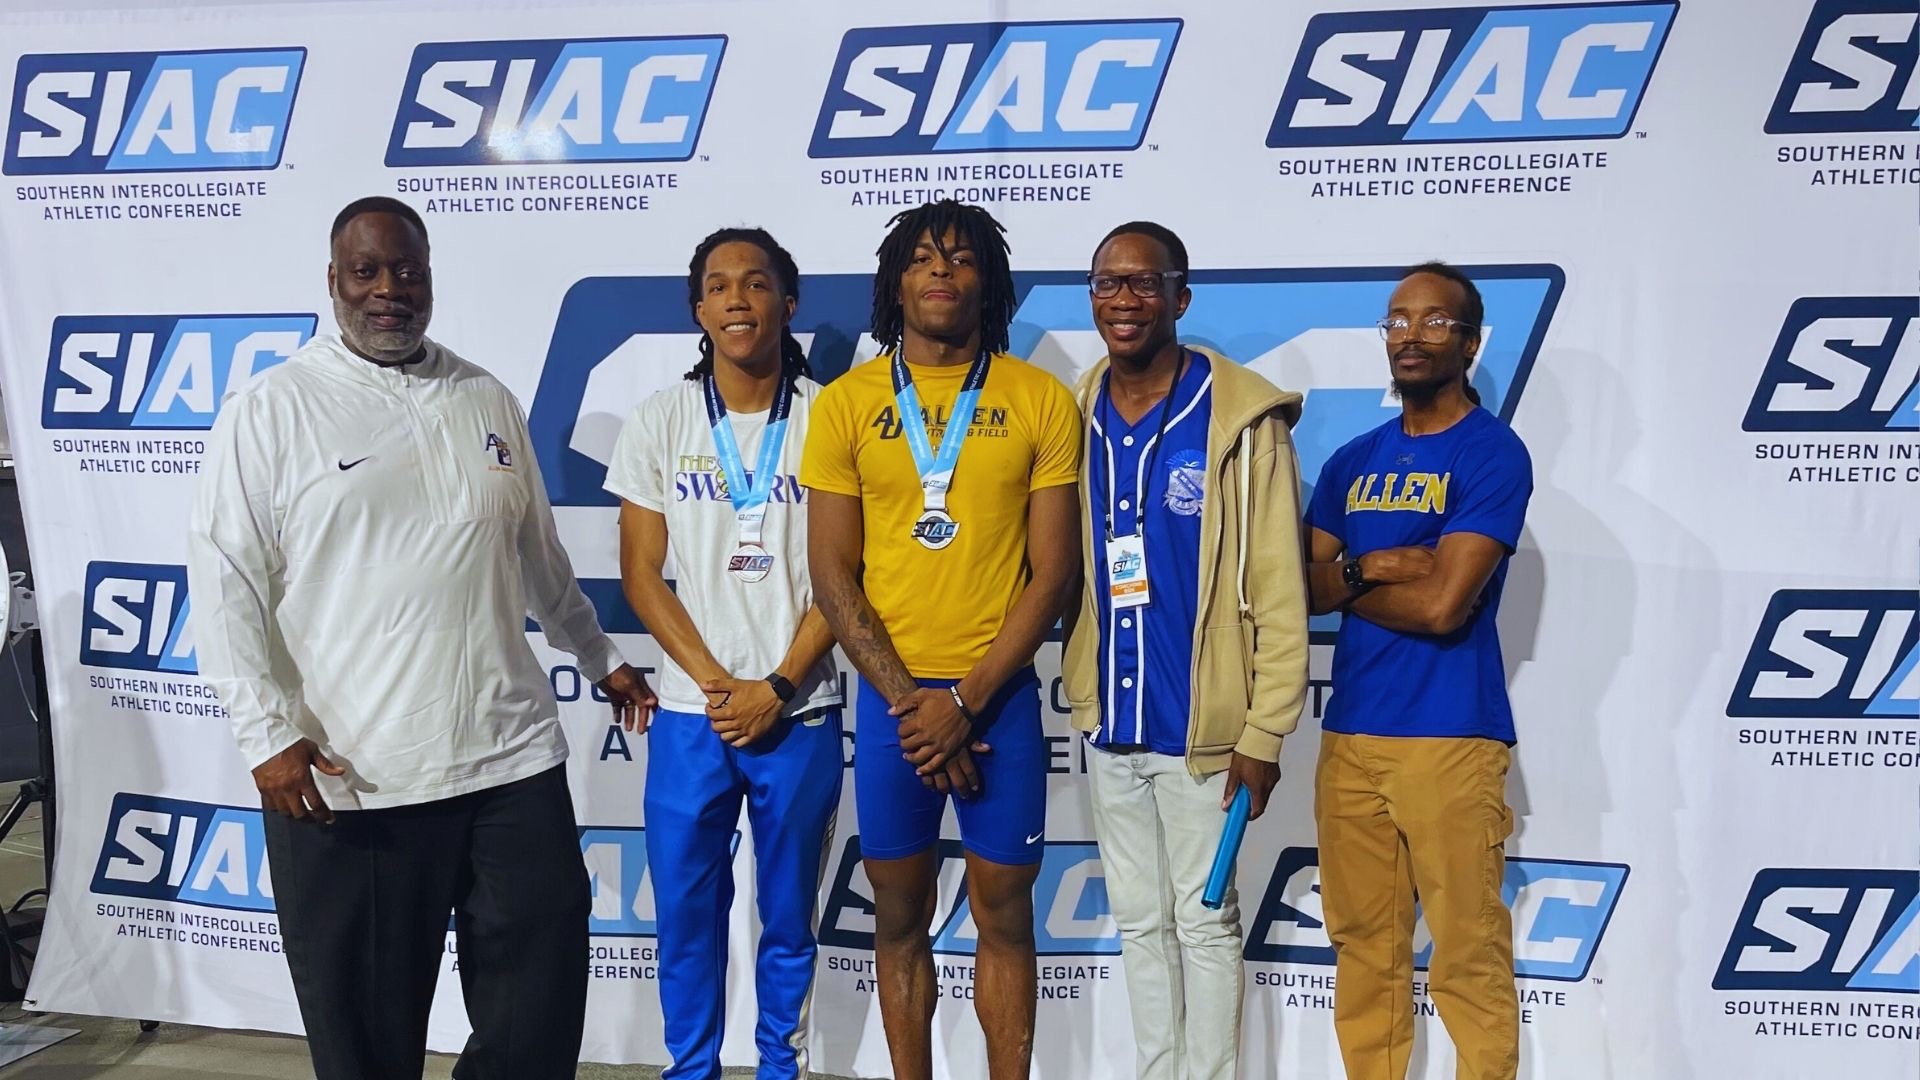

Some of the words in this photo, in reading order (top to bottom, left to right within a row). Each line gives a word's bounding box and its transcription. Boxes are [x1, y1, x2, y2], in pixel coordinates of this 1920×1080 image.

[1287, 21, 1655, 128] SIAC
[828, 38, 1161, 139] SIAC
[402, 54, 708, 148] SIAC
[17, 66, 290, 157] SIAC
[1777, 145, 1905, 162] SOUTHERN
[1278, 158, 1397, 175] SOUTHERN
[1406, 152, 1608, 172] INTERCOLLEGIATE
[397, 177, 498, 192] SOUTHERN
[506, 174, 678, 191] INTERCOLLEGIATE
[820, 167, 928, 185] SOUTHERN
[937, 163, 1124, 181] INTERCOLLEGIATE
[16, 183, 105, 201] SOUTHERN
[112, 181, 267, 199] INTERCOLLEGIATE
[1310, 180, 1415, 197] ATHLETIC
[1423, 176, 1571, 194] CONFERENCE
[426, 197, 515, 213] ATHLETIC
[522, 195, 649, 212] CONFERENCE
[851, 188, 947, 206] ATHLETIC
[953, 186, 1091, 204] CONFERENCE
[43, 204, 121, 220] ATHLETIC
[128, 202, 242, 219] CONFERENCE
[920, 405, 1009, 428] ALEN
[978, 427, 1009, 438] FIELD
[53, 439, 130, 454] SOUTHERN
[1755, 444, 1879, 459] SOUTHERN
[79, 458, 146, 473] ATHLETIC
[679, 455, 717, 472] THE
[1788, 467, 1896, 482] ATHLETIC
[1345, 472, 1451, 516] ALLEN
[729, 556, 771, 570] SIAC
[1113, 559, 1141, 573] SIAC
[90, 676, 158, 694] SOUTHERN
[111, 696, 171, 713] ATHLETIC
[1739, 729, 1857, 745] SOUTHERN
[1771, 752, 1874, 767] ATHLETIC
[97, 903, 175, 923] SOUTHERN
[180, 912, 277, 935] INTERCOLLEG
[117, 924, 187, 943] ATHLETIC
[191, 932, 286, 954] CONFERENC
[1724, 1001, 1840, 1016] SOUTHERN
[1755, 1022, 1857, 1037] ATHLETIC
